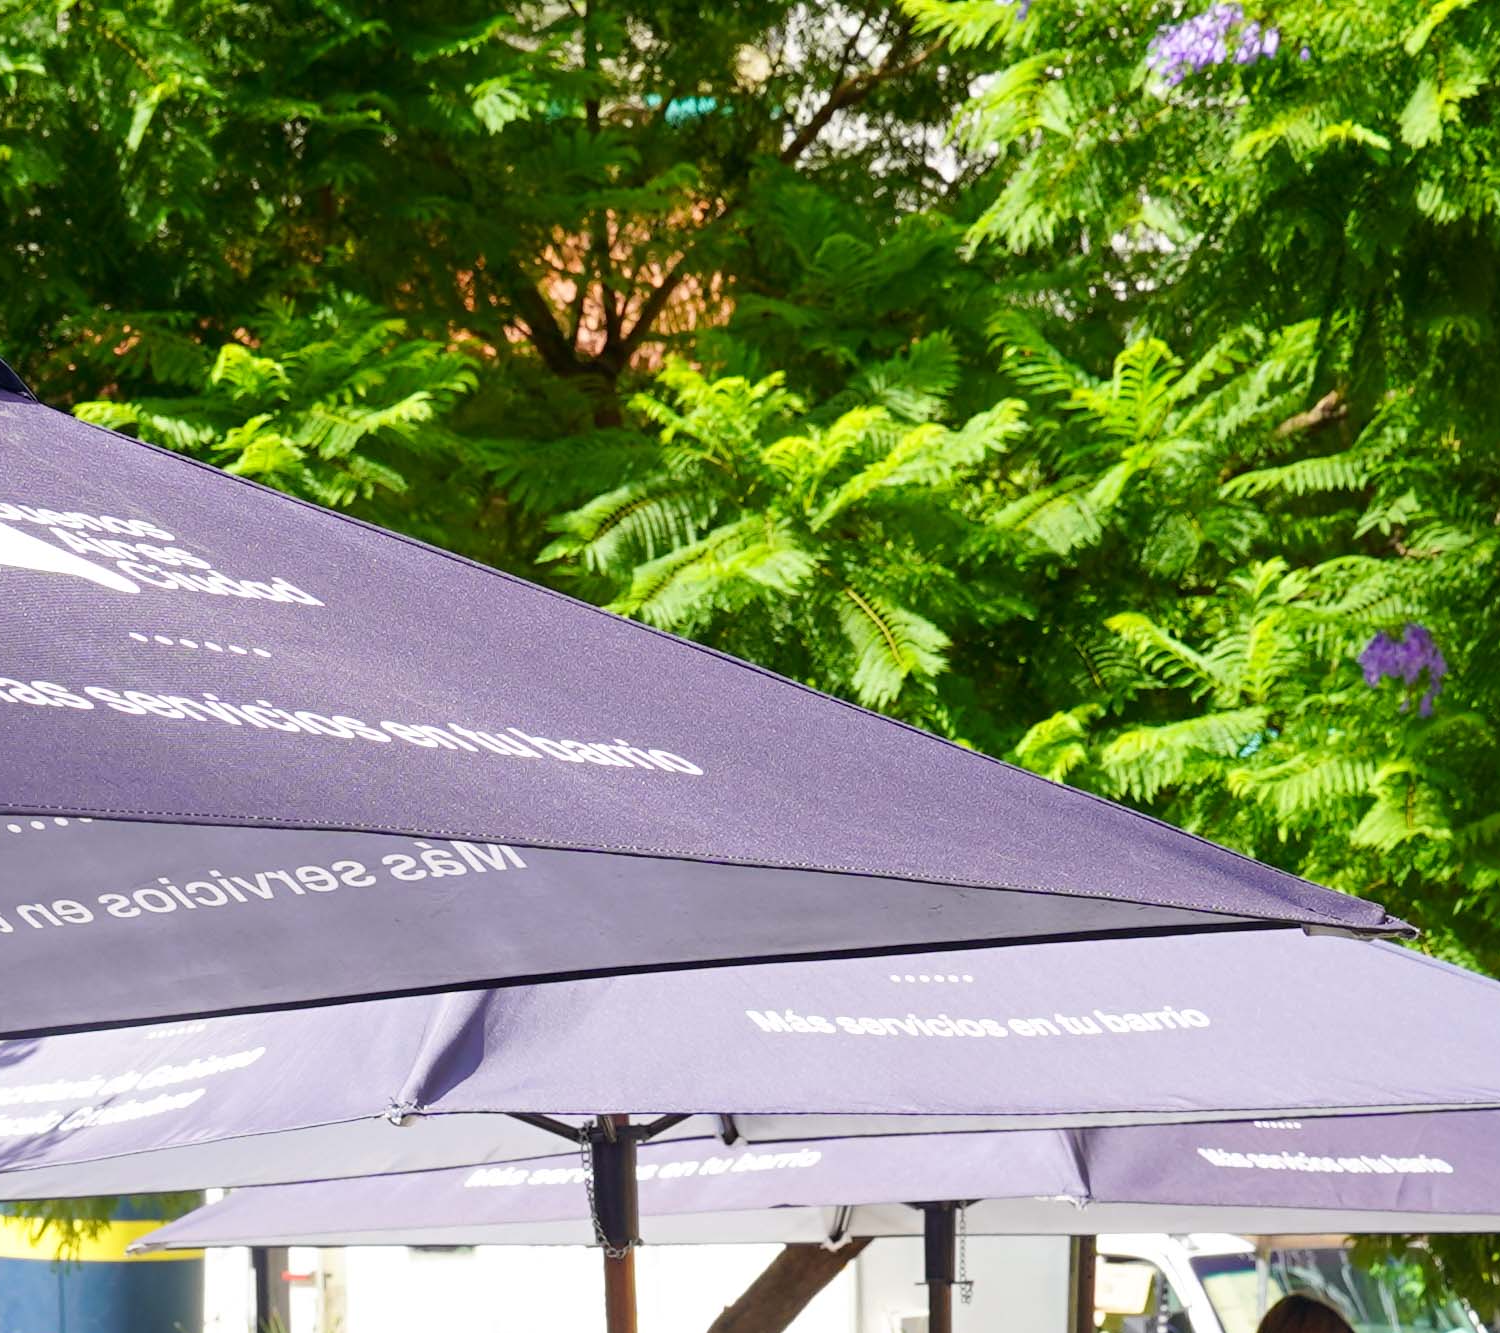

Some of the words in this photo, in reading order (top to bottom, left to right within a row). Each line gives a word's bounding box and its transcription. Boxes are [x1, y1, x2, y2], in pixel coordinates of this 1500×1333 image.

[48, 525, 212, 570] Aires
[116, 560, 325, 607] Ciudad
[83, 685, 391, 743] servicios
[379, 719, 464, 751] en
[446, 721, 540, 759] tu
[509, 726, 705, 776] barrio
[745, 1008, 837, 1034] Más
[834, 1011, 1010, 1039] servicios
[1006, 1014, 1061, 1038] en
[1053, 1011, 1102, 1036] tu
[1092, 1005, 1212, 1034] barrio
